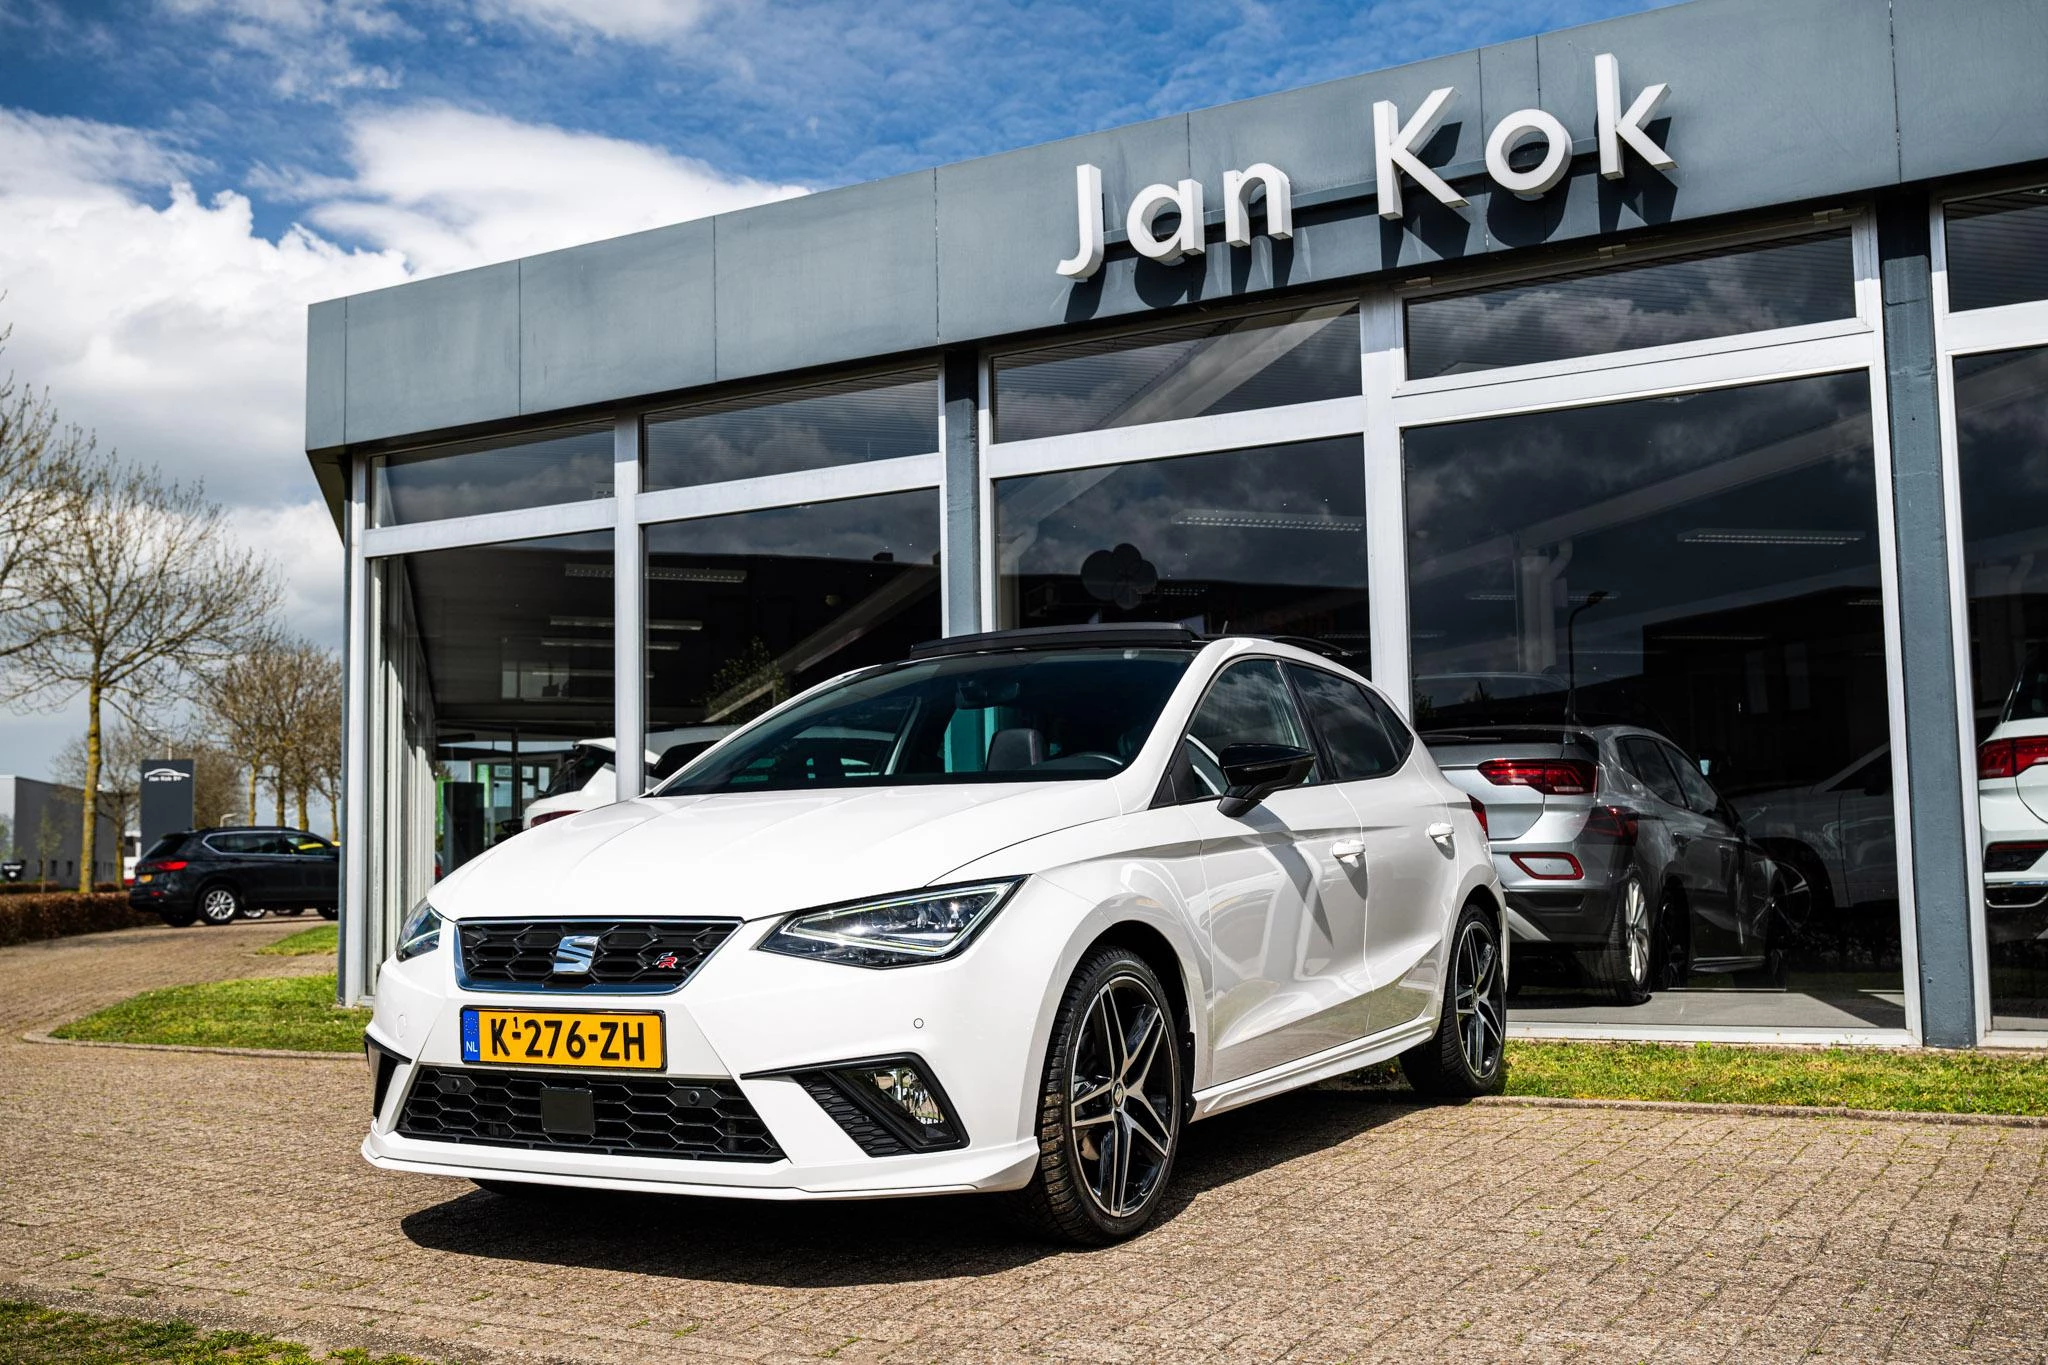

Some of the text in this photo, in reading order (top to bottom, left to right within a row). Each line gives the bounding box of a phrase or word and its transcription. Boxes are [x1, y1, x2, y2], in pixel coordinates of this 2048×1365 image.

[1056, 52, 1680, 282] Jan Kok
[465, 1040, 479, 1053] NL
[490, 1017, 645, 1061] K-276-ZH
